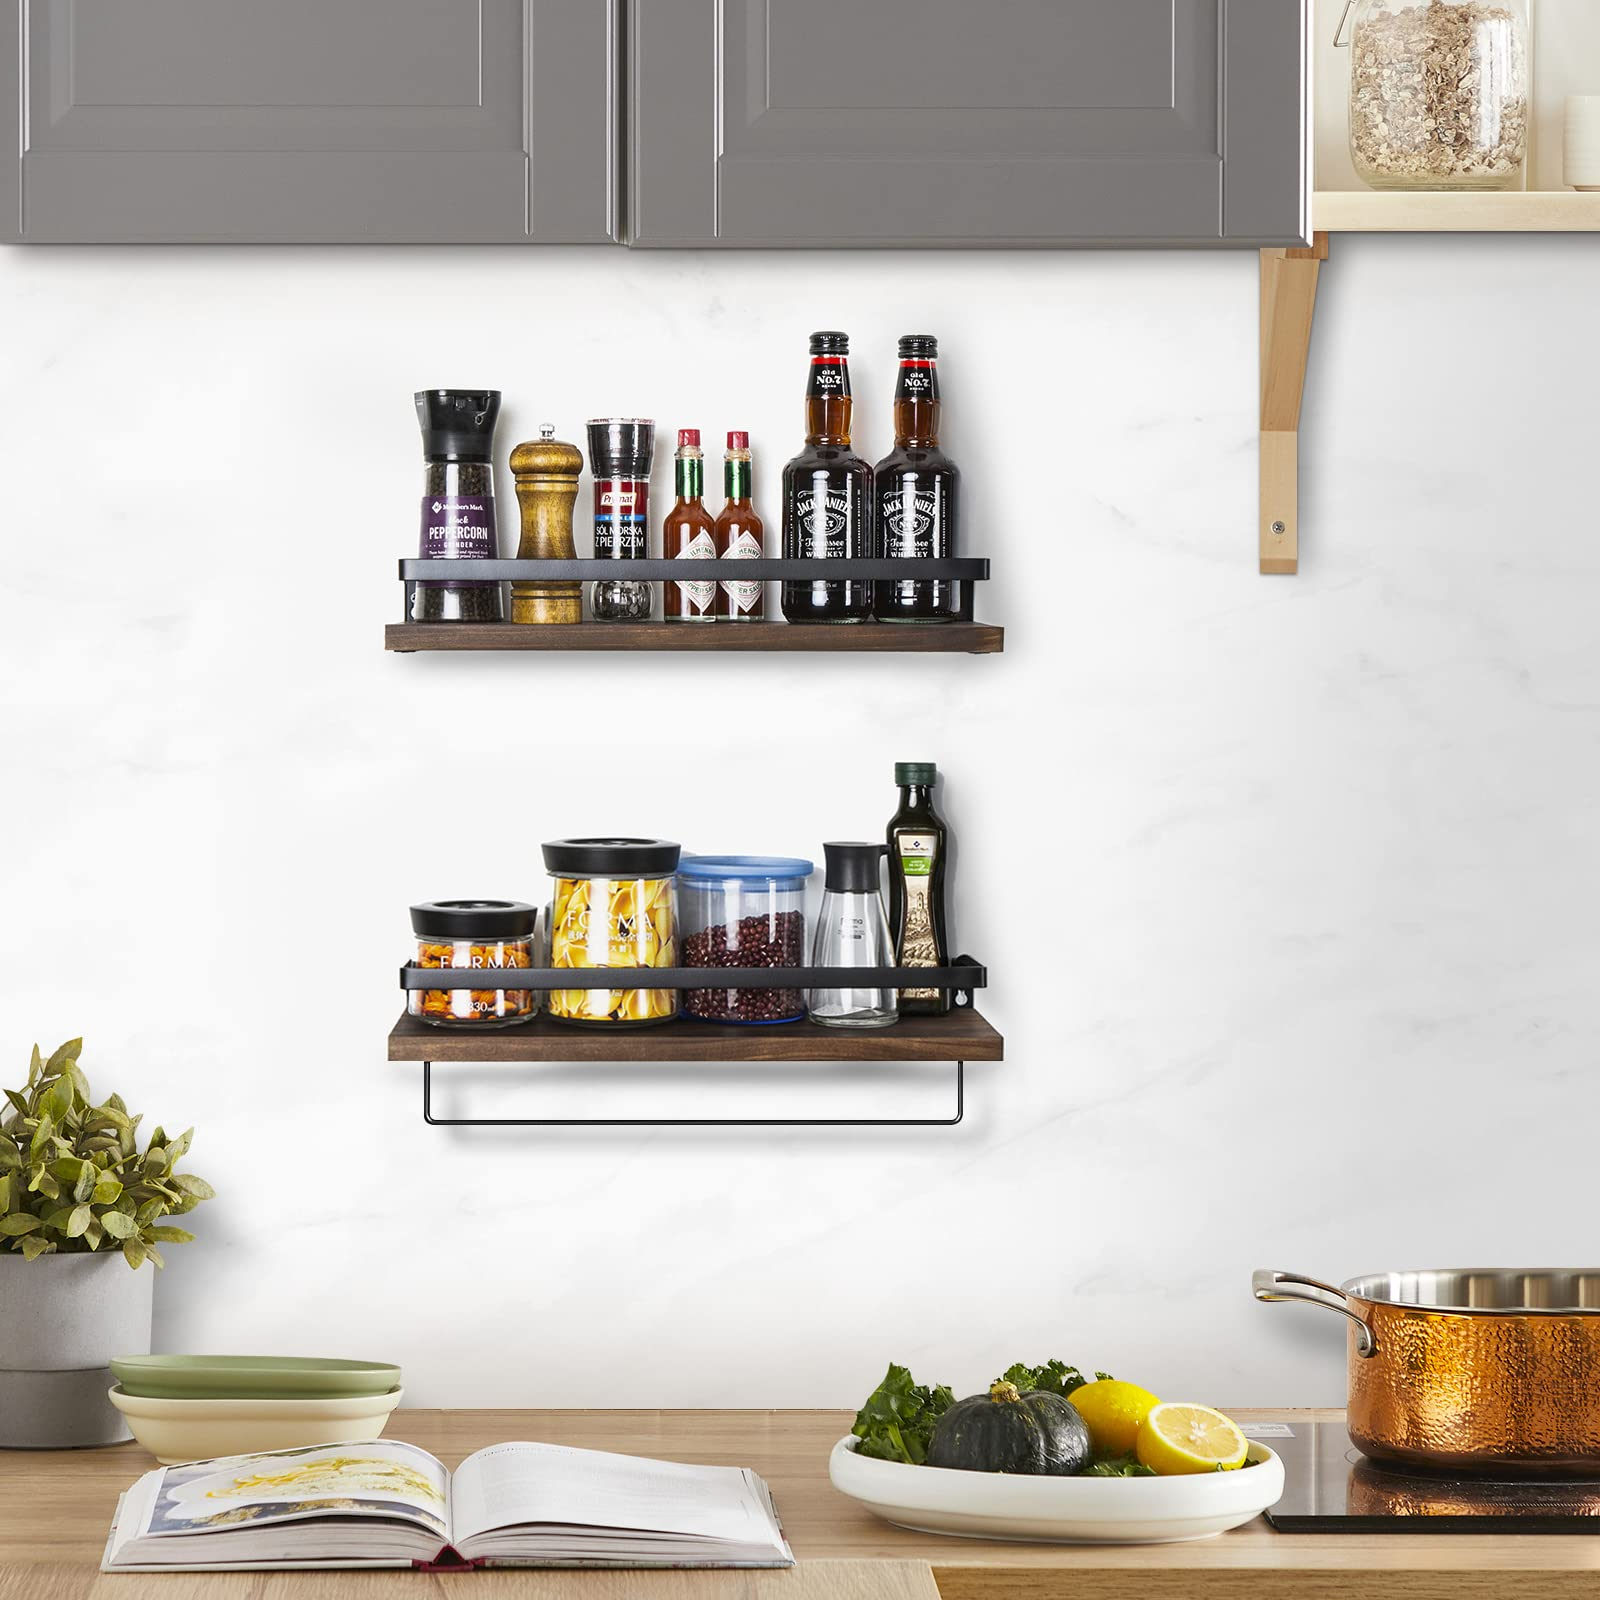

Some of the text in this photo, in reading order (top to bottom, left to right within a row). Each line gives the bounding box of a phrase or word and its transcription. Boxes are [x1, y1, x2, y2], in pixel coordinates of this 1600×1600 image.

[796, 497, 818, 517] JACK
[883, 498, 902, 517] JACK
[429, 526, 488, 540] PEPPERCORN
[596, 524, 609, 536] SÓL
[595, 536, 600, 548] Z
